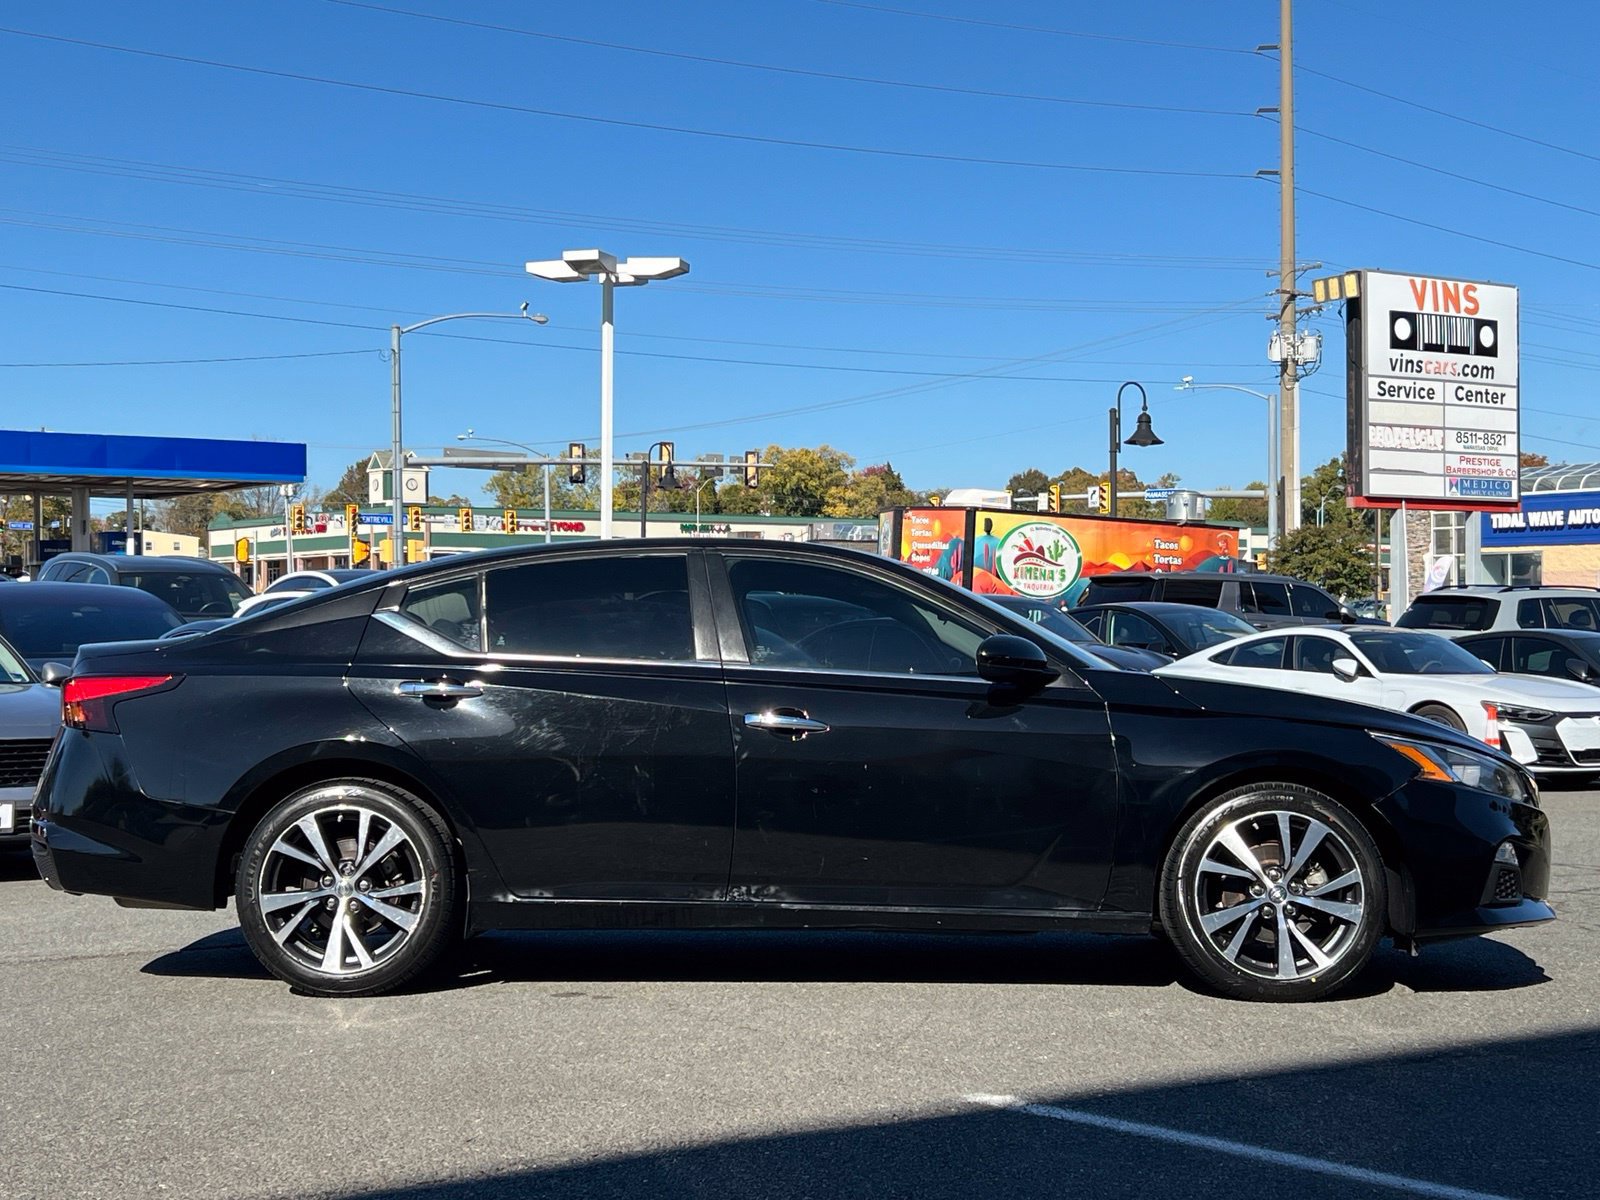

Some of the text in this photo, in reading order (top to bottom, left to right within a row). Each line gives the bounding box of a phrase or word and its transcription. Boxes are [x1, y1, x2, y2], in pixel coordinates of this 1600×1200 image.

[1409, 278, 1480, 316] VINS
[1389, 353, 1495, 380] vinscars.com
[1377, 380, 1506, 405] Service Center
[1455, 431, 1507, 447] 8511-8521
[1459, 456, 1501, 467] PRESTIGE
[1446, 466, 1497, 476] BARBERSHOP
[1498, 468, 1504, 476] &
[1463, 479, 1510, 490] MEDICO
[911, 516, 929, 525] Tacos
[1490, 508, 1600, 530] TIDAL WAVE AUTO
[911, 529, 933, 537] Tortas
[911, 541, 950, 551] Quesadillas
[1153, 538, 1180, 551] Tacos
[1153, 552, 1184, 566] Tortas
[1013, 566, 1067, 582] XIMENA'S
